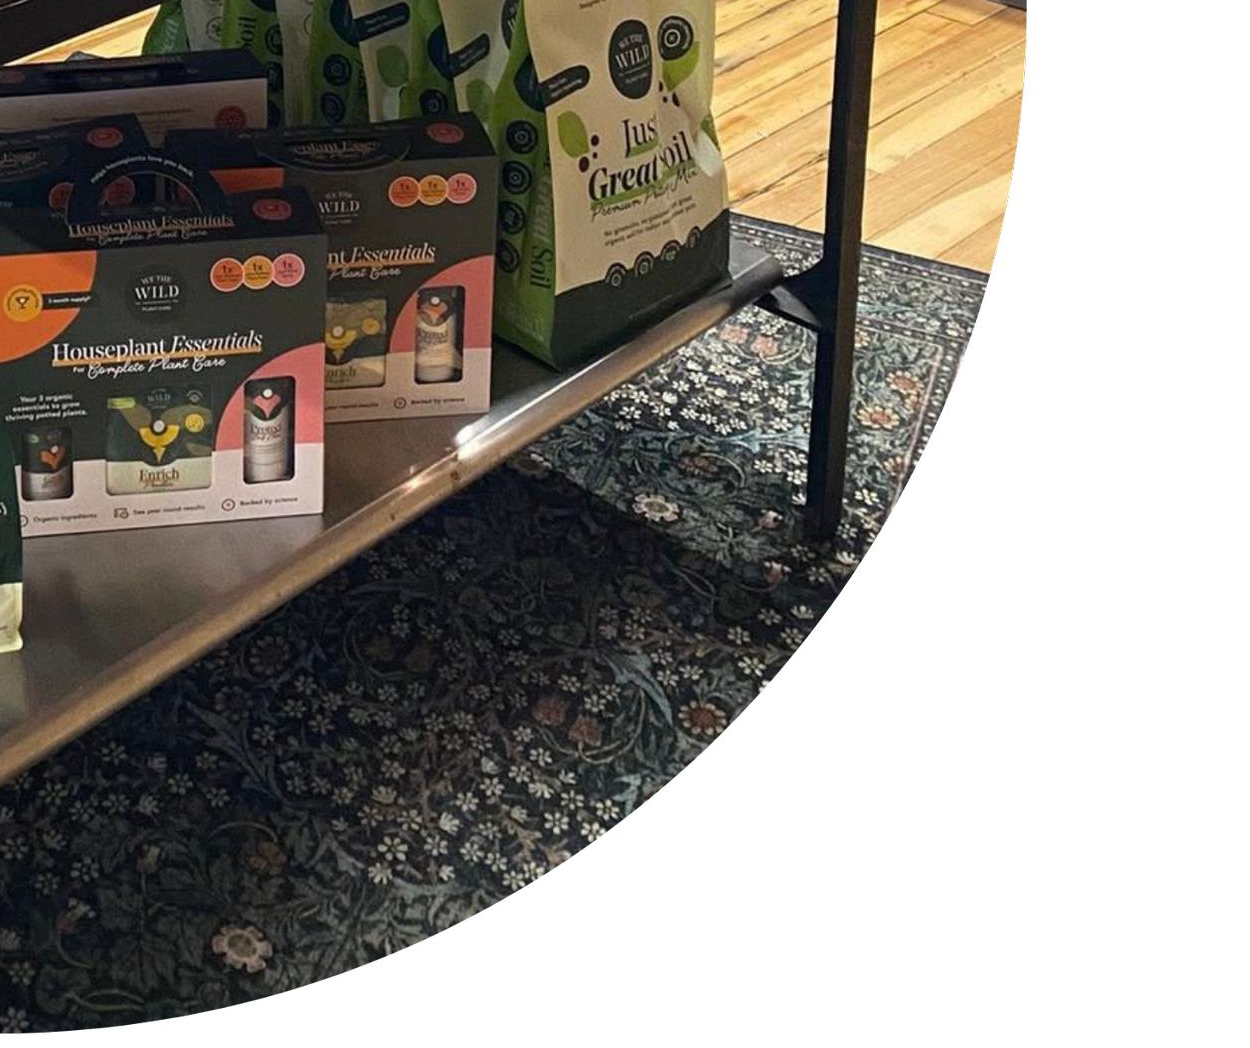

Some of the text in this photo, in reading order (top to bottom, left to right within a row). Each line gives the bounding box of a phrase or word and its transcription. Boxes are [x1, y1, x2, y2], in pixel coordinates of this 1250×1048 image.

[614, 44, 649, 69] WILD
[622, 116, 657, 158] Jus
[660, 131, 693, 169] oil
[428, 181, 438, 189] 1x
[455, 179, 466, 188] 1x
[319, 199, 360, 214] WILD
[351, 242, 436, 263] Essentials
[222, 265, 232, 273] 1x
[253, 263, 263, 271] 1x
[283, 260, 293, 269] 1x
[530, 246, 554, 290] Soil
[329, 265, 401, 281] Plant Care
[135, 285, 179, 300] WILD
[53, 330, 263, 362] Houseplant Essentials
[88, 360, 145, 380] Complete
[148, 355, 189, 373] Plant
[192, 354, 226, 372] Care
[45, 394, 73, 403] organic
[12, 404, 50, 412] essentials
[61, 402, 80, 410] grow
[5, 413, 35, 422] thriving
[36, 411, 61, 420] potted
[139, 467, 180, 482] Enrich
[33, 516, 58, 524] Organic
